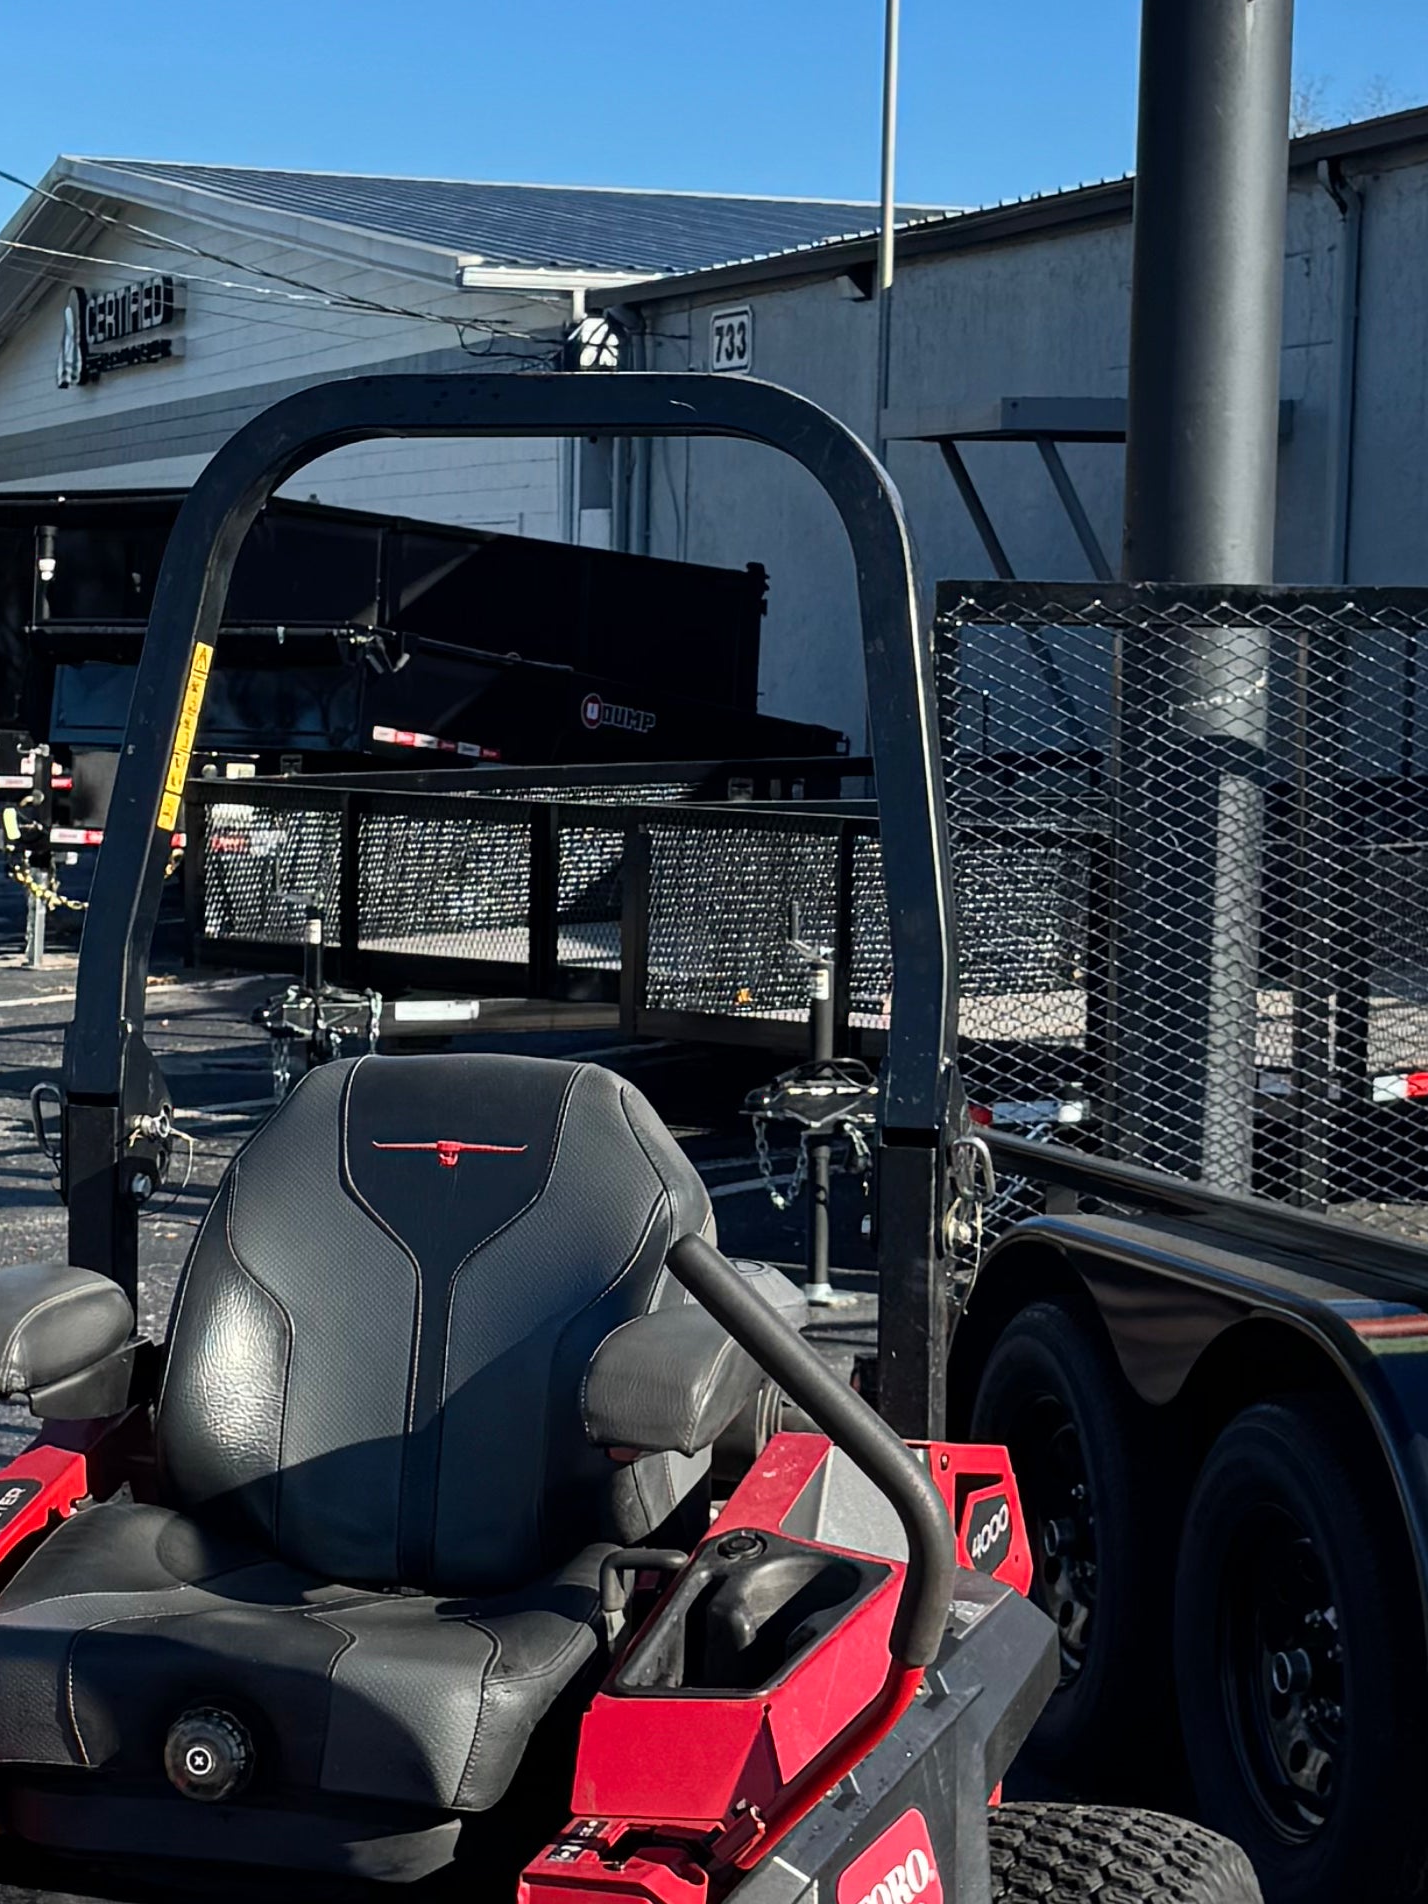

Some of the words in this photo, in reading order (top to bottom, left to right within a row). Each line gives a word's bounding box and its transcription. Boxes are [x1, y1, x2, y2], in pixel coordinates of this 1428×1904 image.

[85, 276, 164, 344] CERTIFIED
[715, 321, 747, 363] 733
[972, 1503, 1009, 1559] 4000
